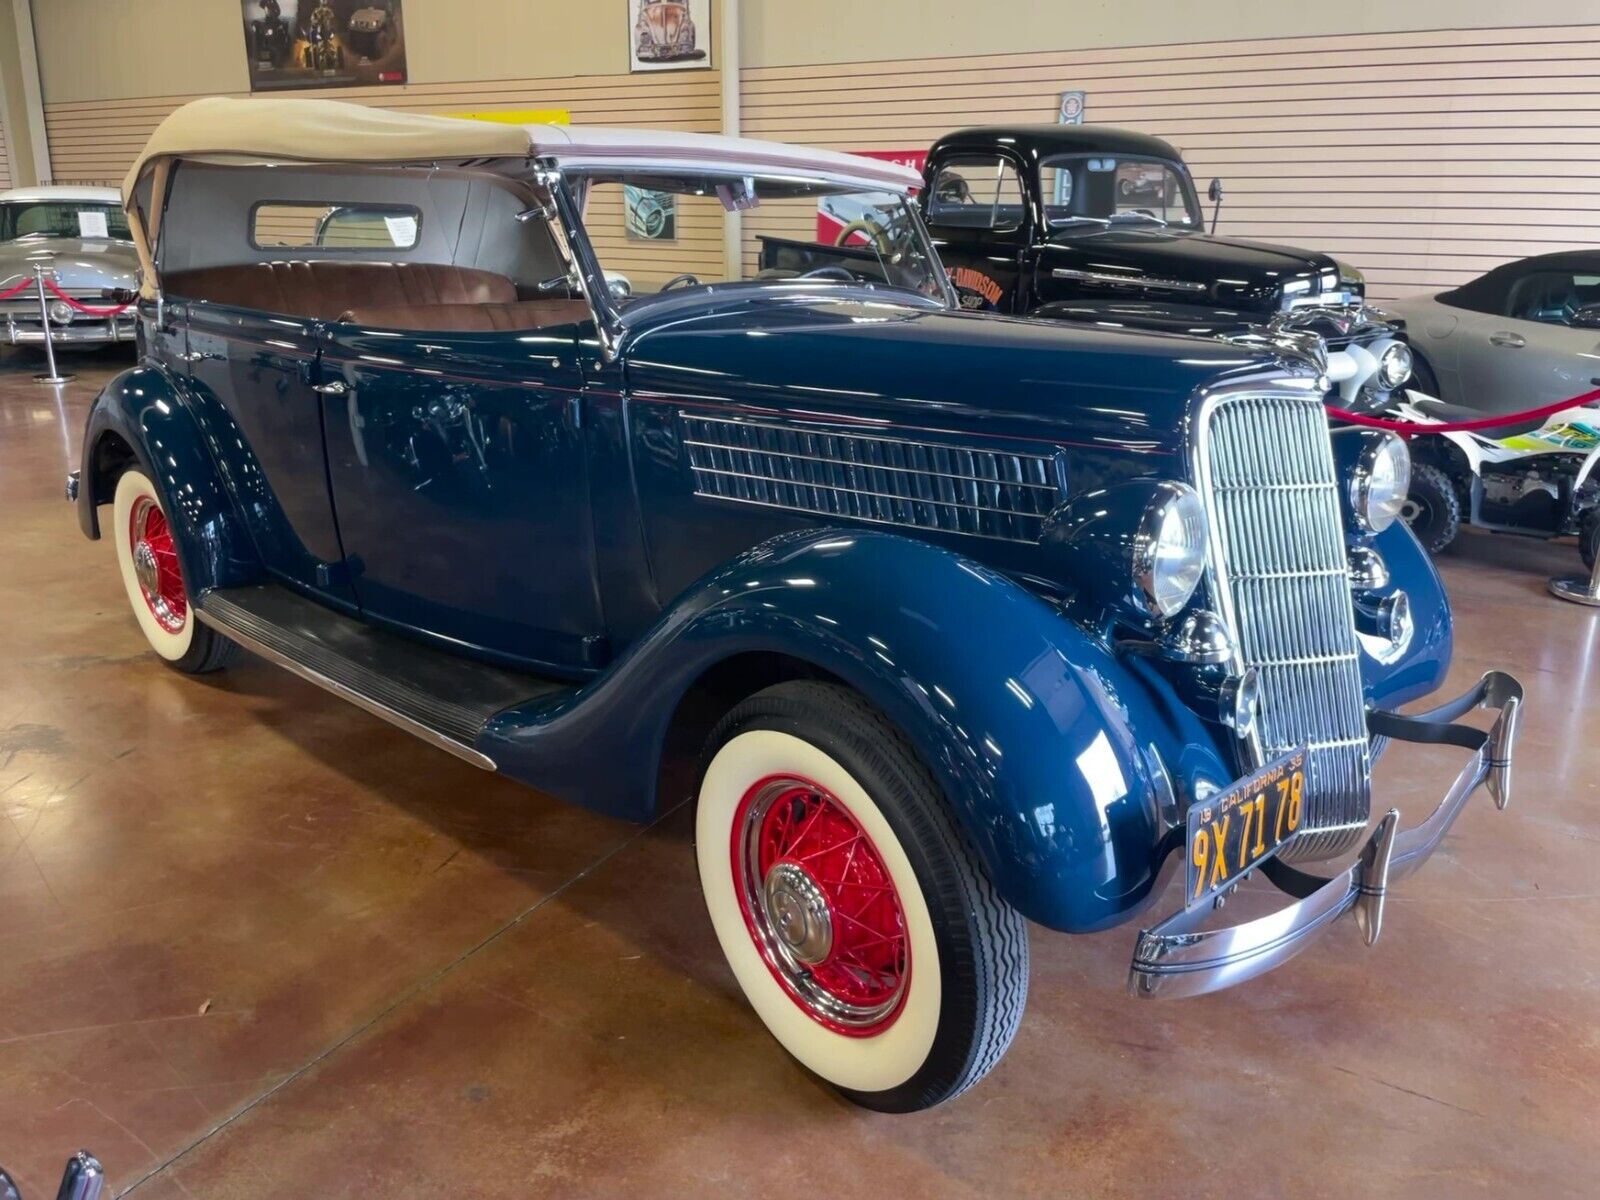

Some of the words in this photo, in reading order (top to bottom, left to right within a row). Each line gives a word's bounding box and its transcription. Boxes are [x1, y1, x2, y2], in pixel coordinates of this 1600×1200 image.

[1193, 814, 1230, 898] 9X
[1239, 793, 1265, 868] 71
[1275, 771, 1304, 842] 78
[1200, 807, 1212, 824] 19
[1221, 765, 1284, 812] CALIFORNIA
